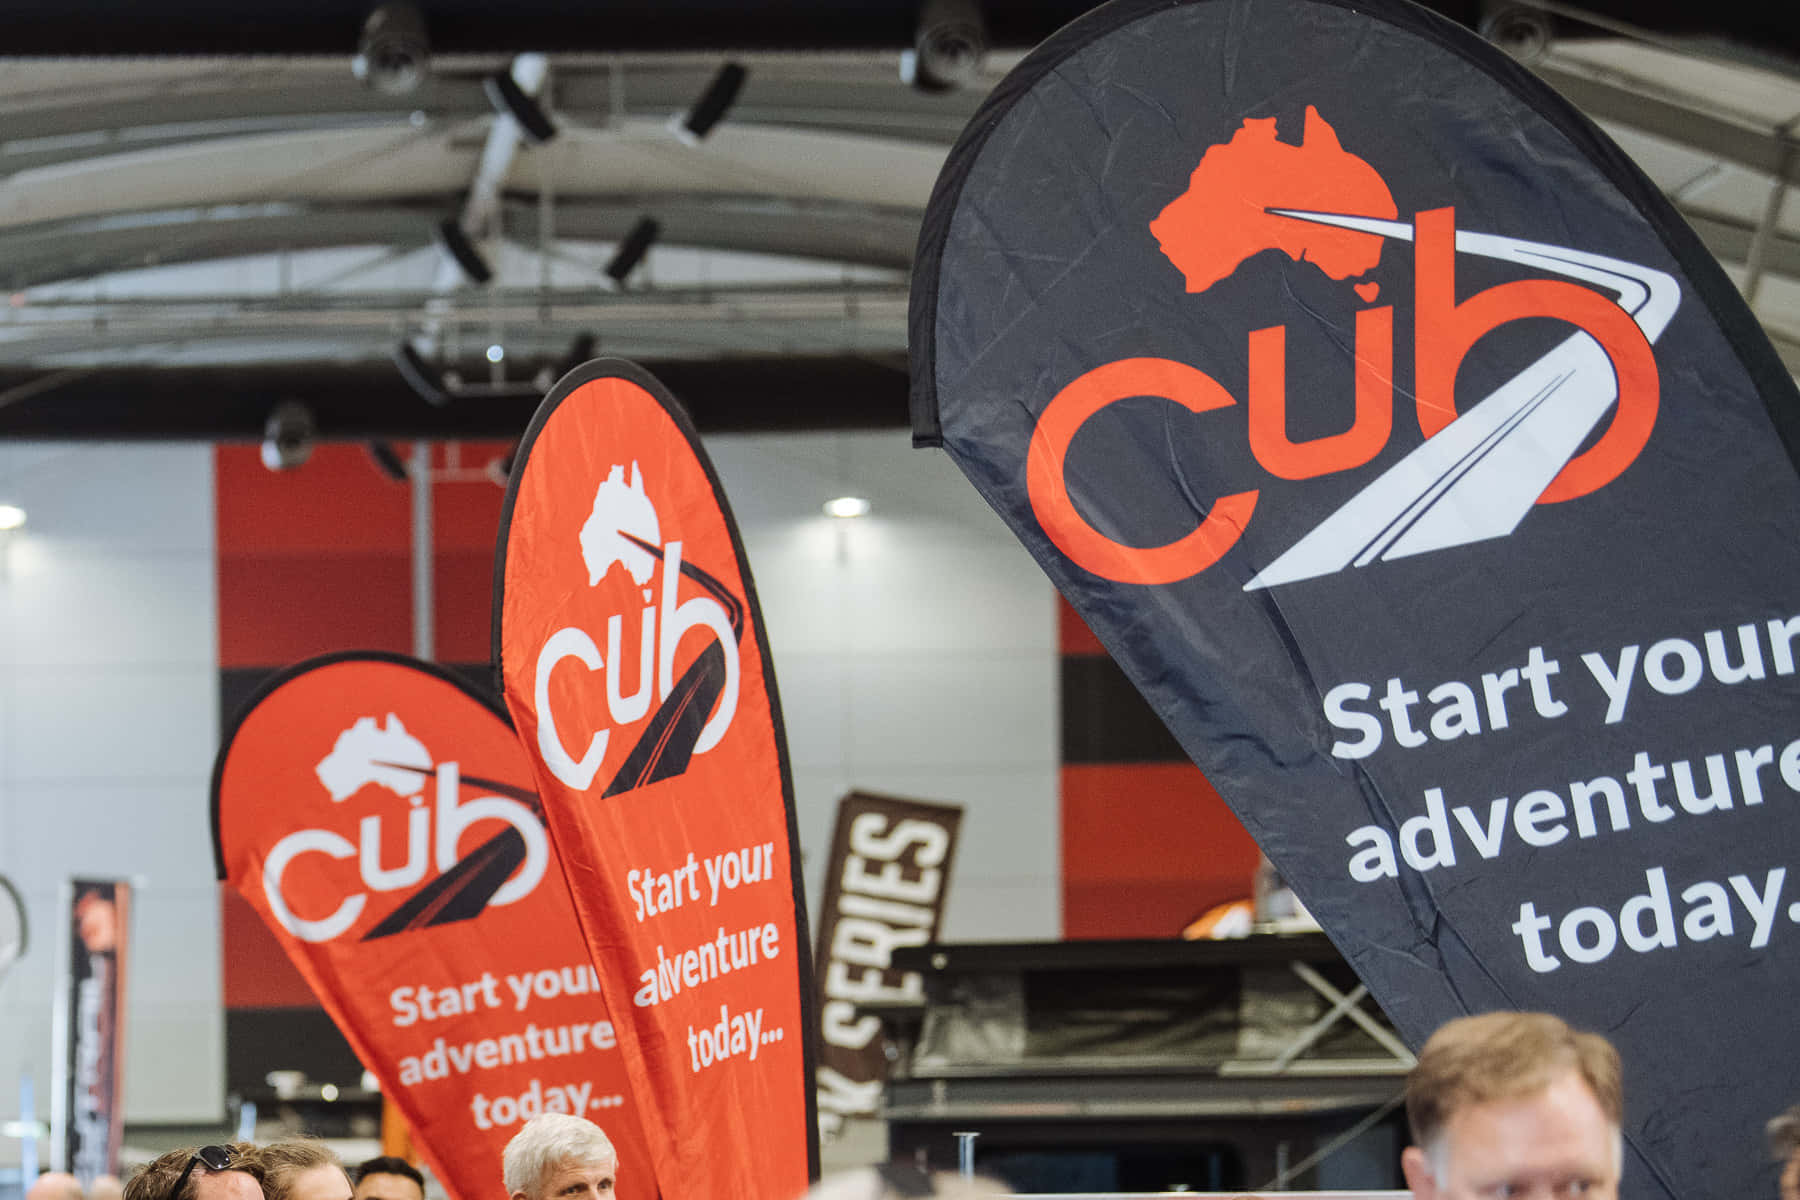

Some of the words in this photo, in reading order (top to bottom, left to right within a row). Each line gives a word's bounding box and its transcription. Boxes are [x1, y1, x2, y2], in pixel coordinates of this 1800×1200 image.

[1322, 646, 1568, 760] Start
[1580, 614, 1800, 725] your
[628, 852, 700, 923] Start
[704, 841, 773, 907] your
[390, 972, 501, 1027] Start
[633, 922, 779, 1008] adventure
[399, 1020, 617, 1086] adventure
[688, 1004, 784, 1073] today...
